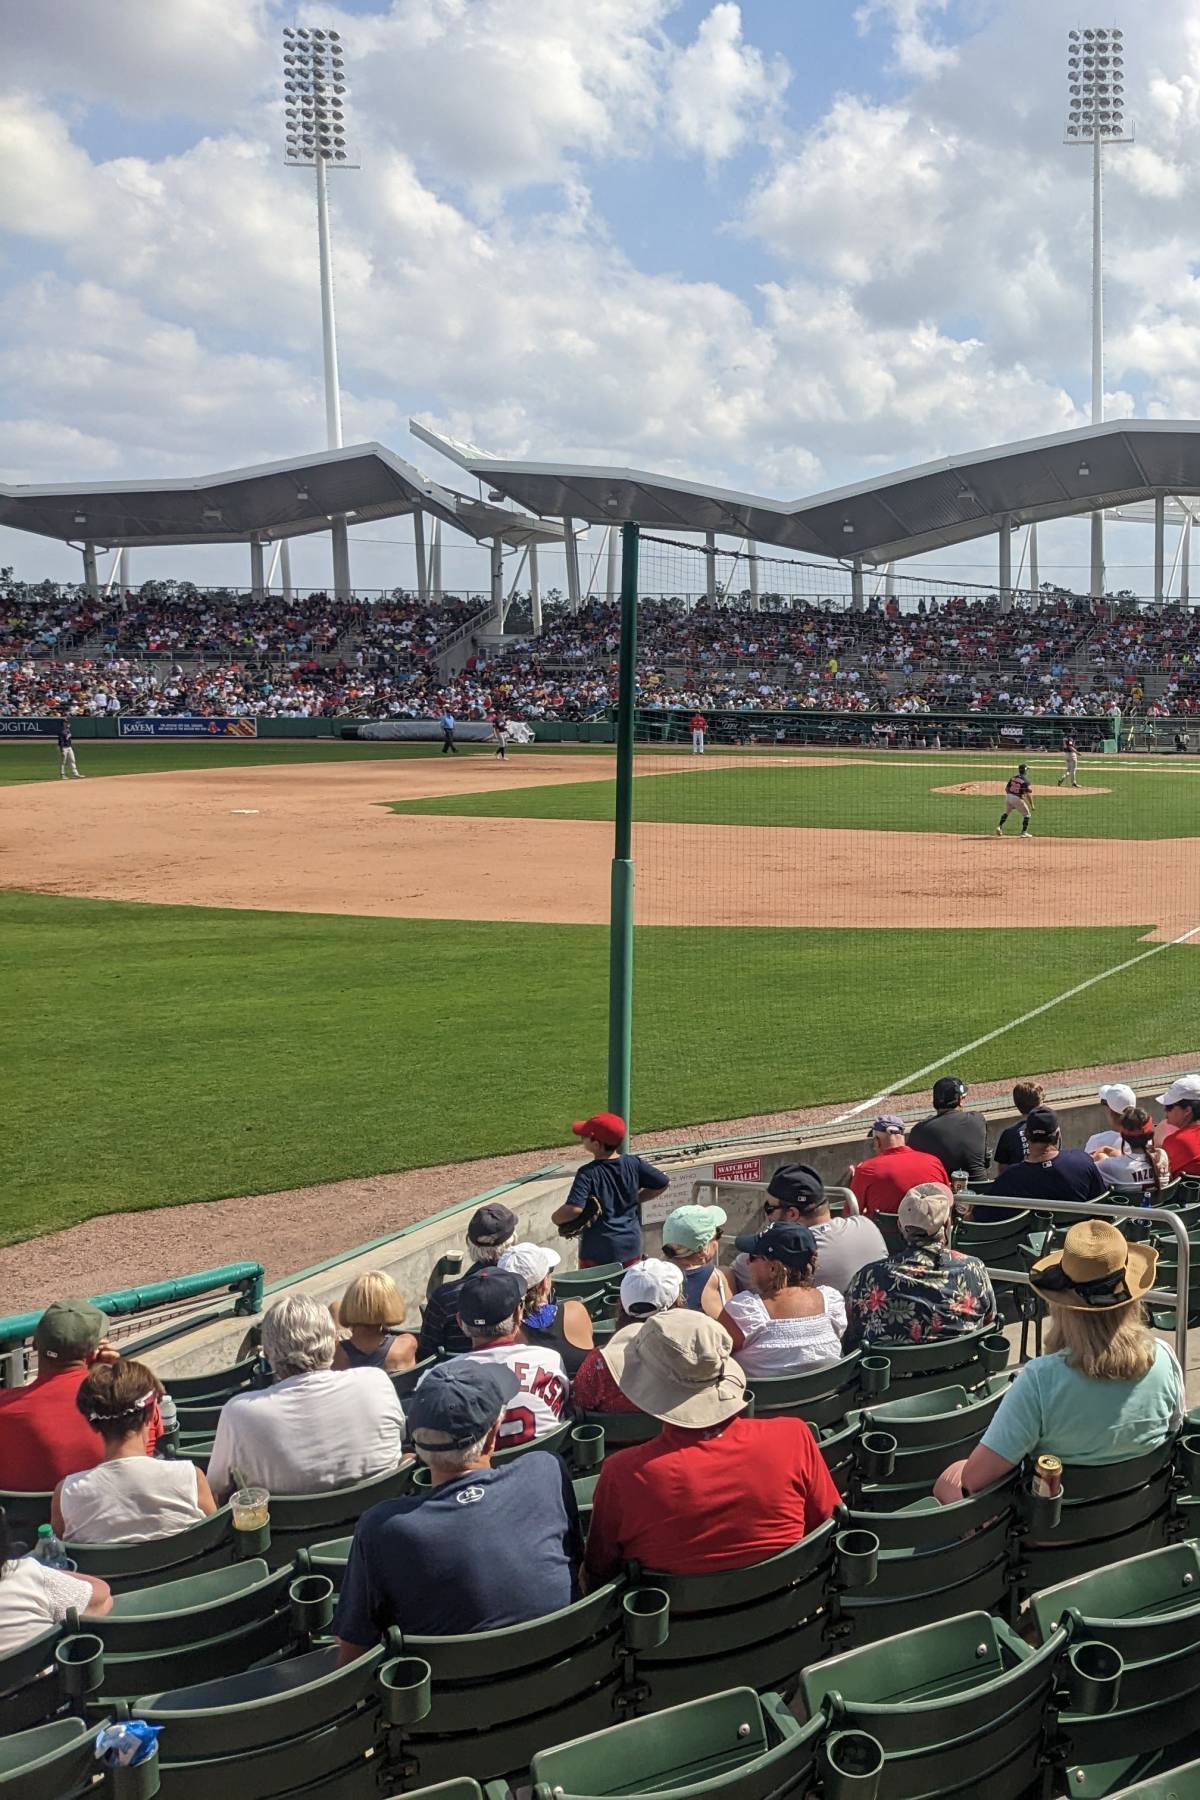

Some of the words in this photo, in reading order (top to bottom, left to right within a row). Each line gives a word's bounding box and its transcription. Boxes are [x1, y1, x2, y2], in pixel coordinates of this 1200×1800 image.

[0, 722, 43, 732] DIGITAL
[123, 722, 155, 735] KAYEM
[718, 1164, 742, 1173] WATCH
[743, 1161, 758, 1169] OUT
